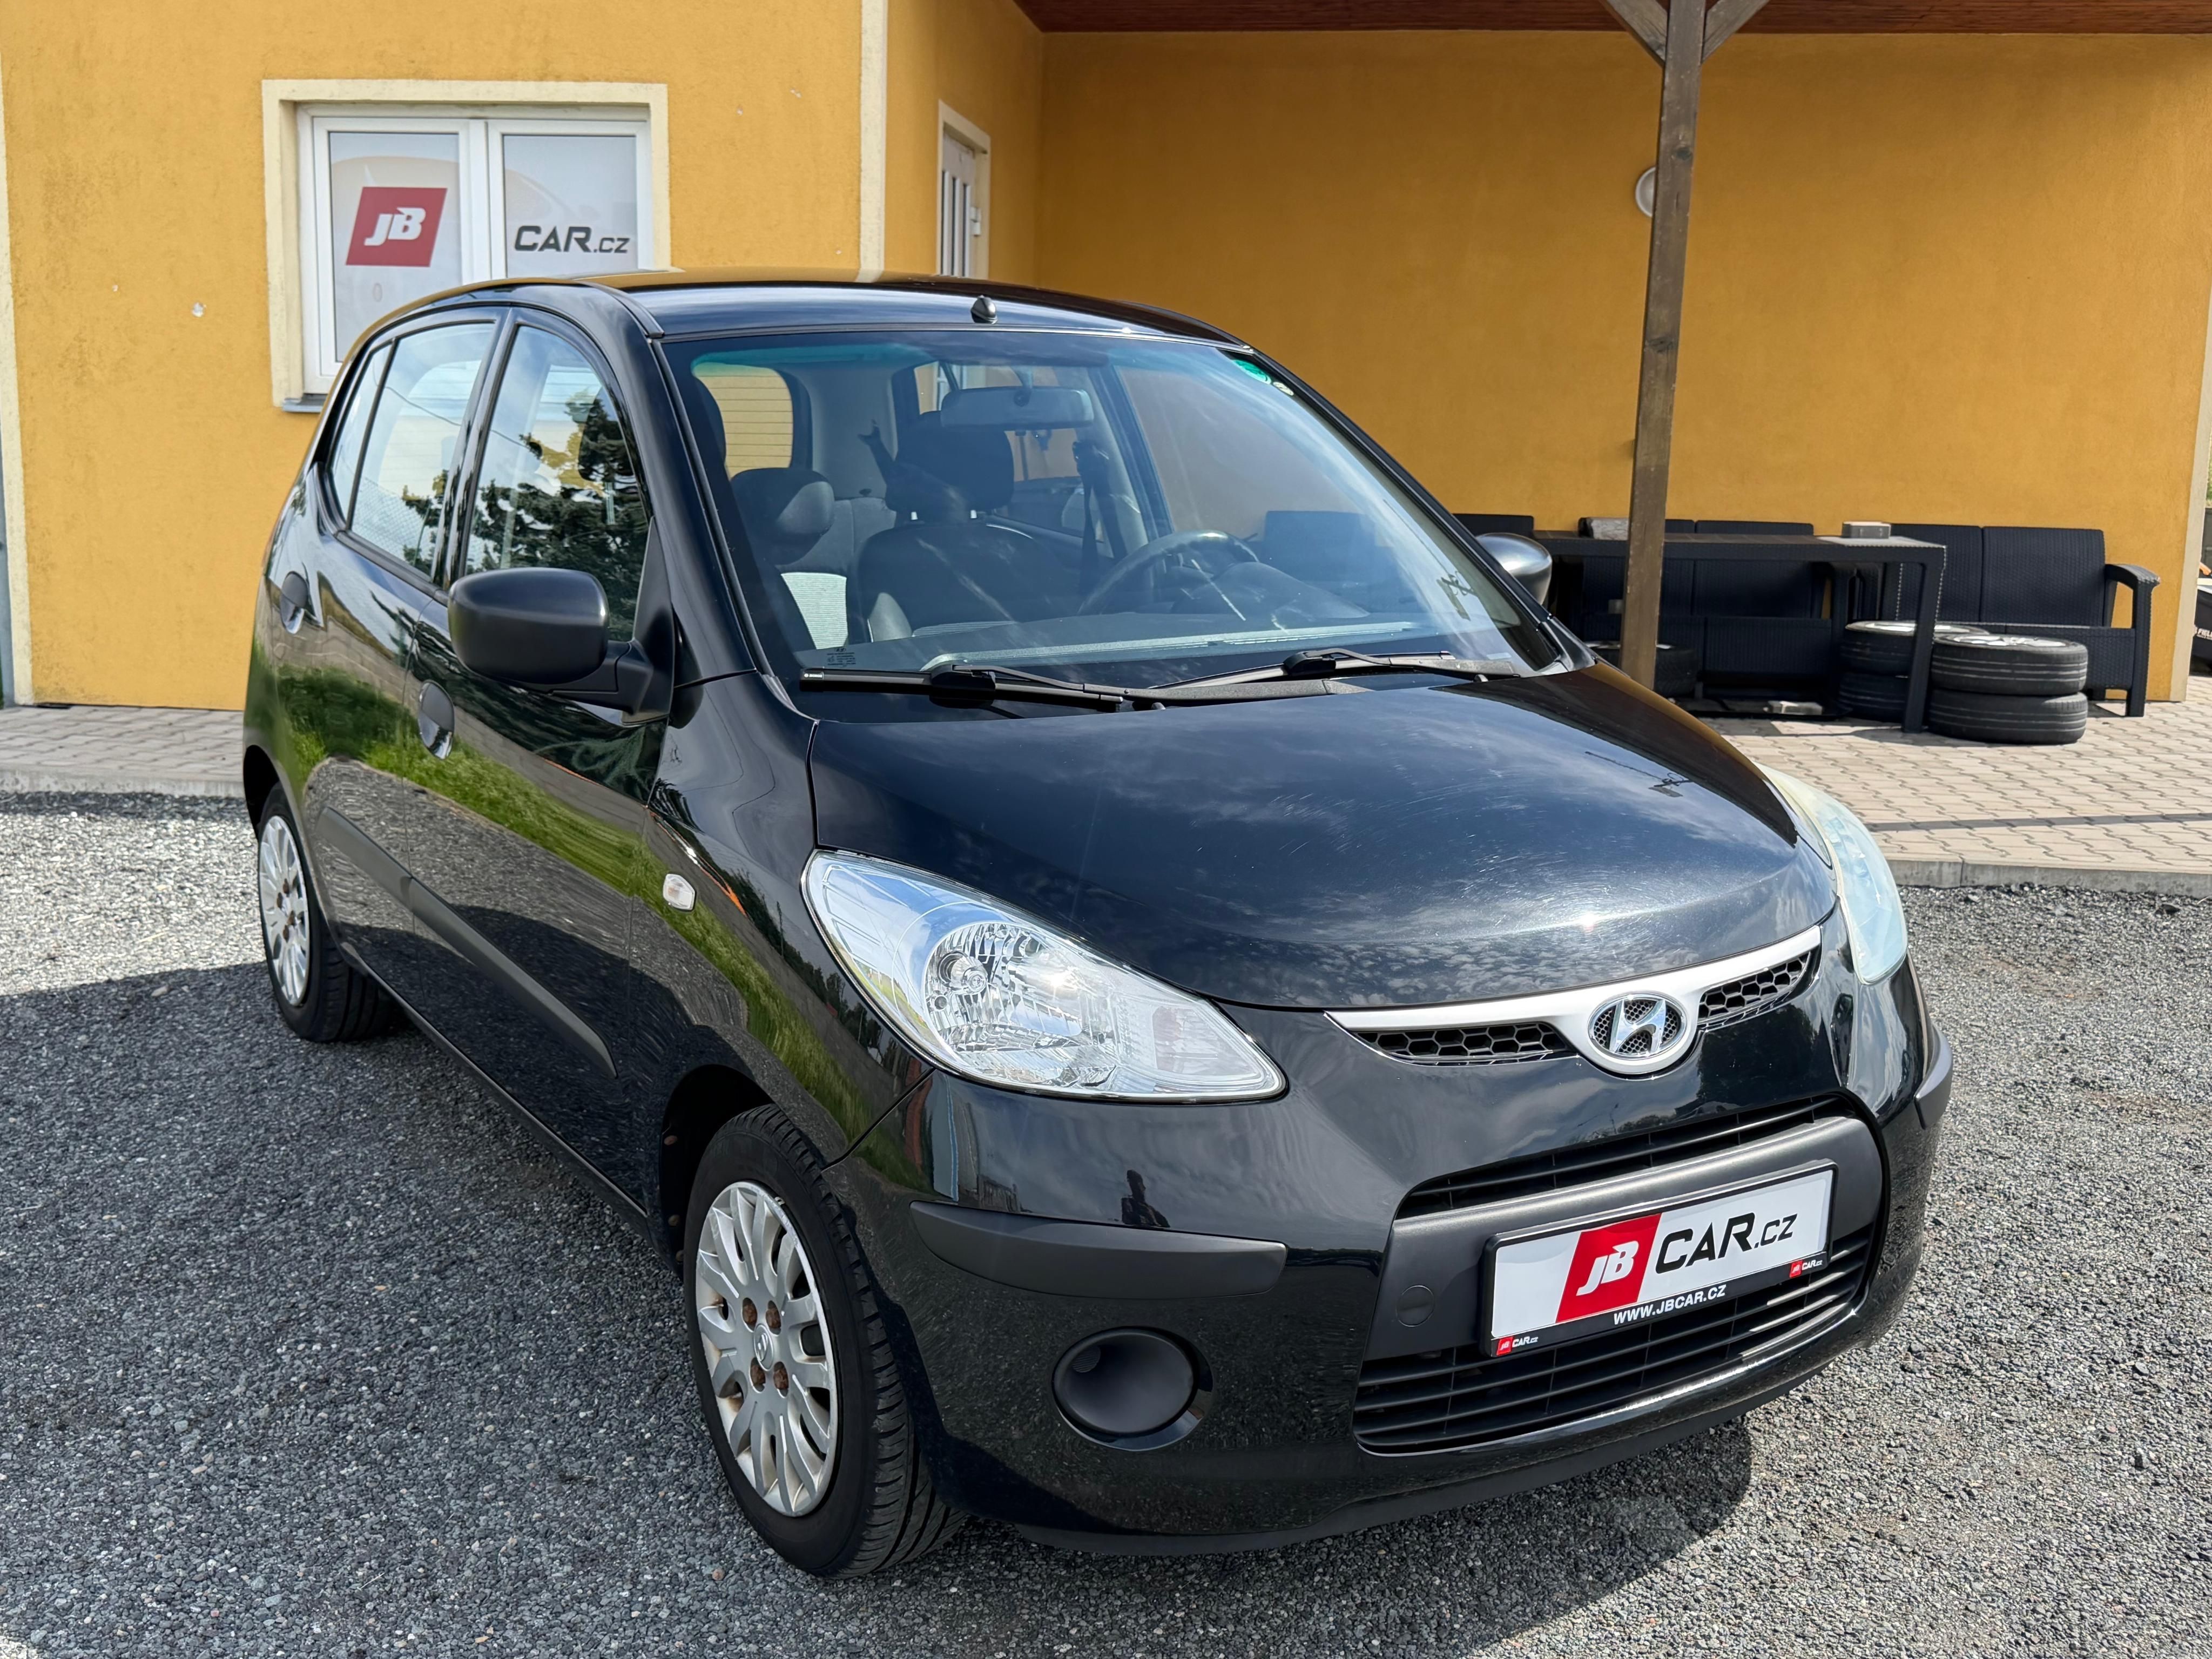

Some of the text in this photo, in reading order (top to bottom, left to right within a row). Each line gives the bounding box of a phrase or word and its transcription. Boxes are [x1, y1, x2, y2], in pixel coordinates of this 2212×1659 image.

[364, 207, 426, 246] JB
[1576, 1240, 1639, 1296] JB
[1614, 1285, 1727, 1325] WWW.JBCAR.CZ
